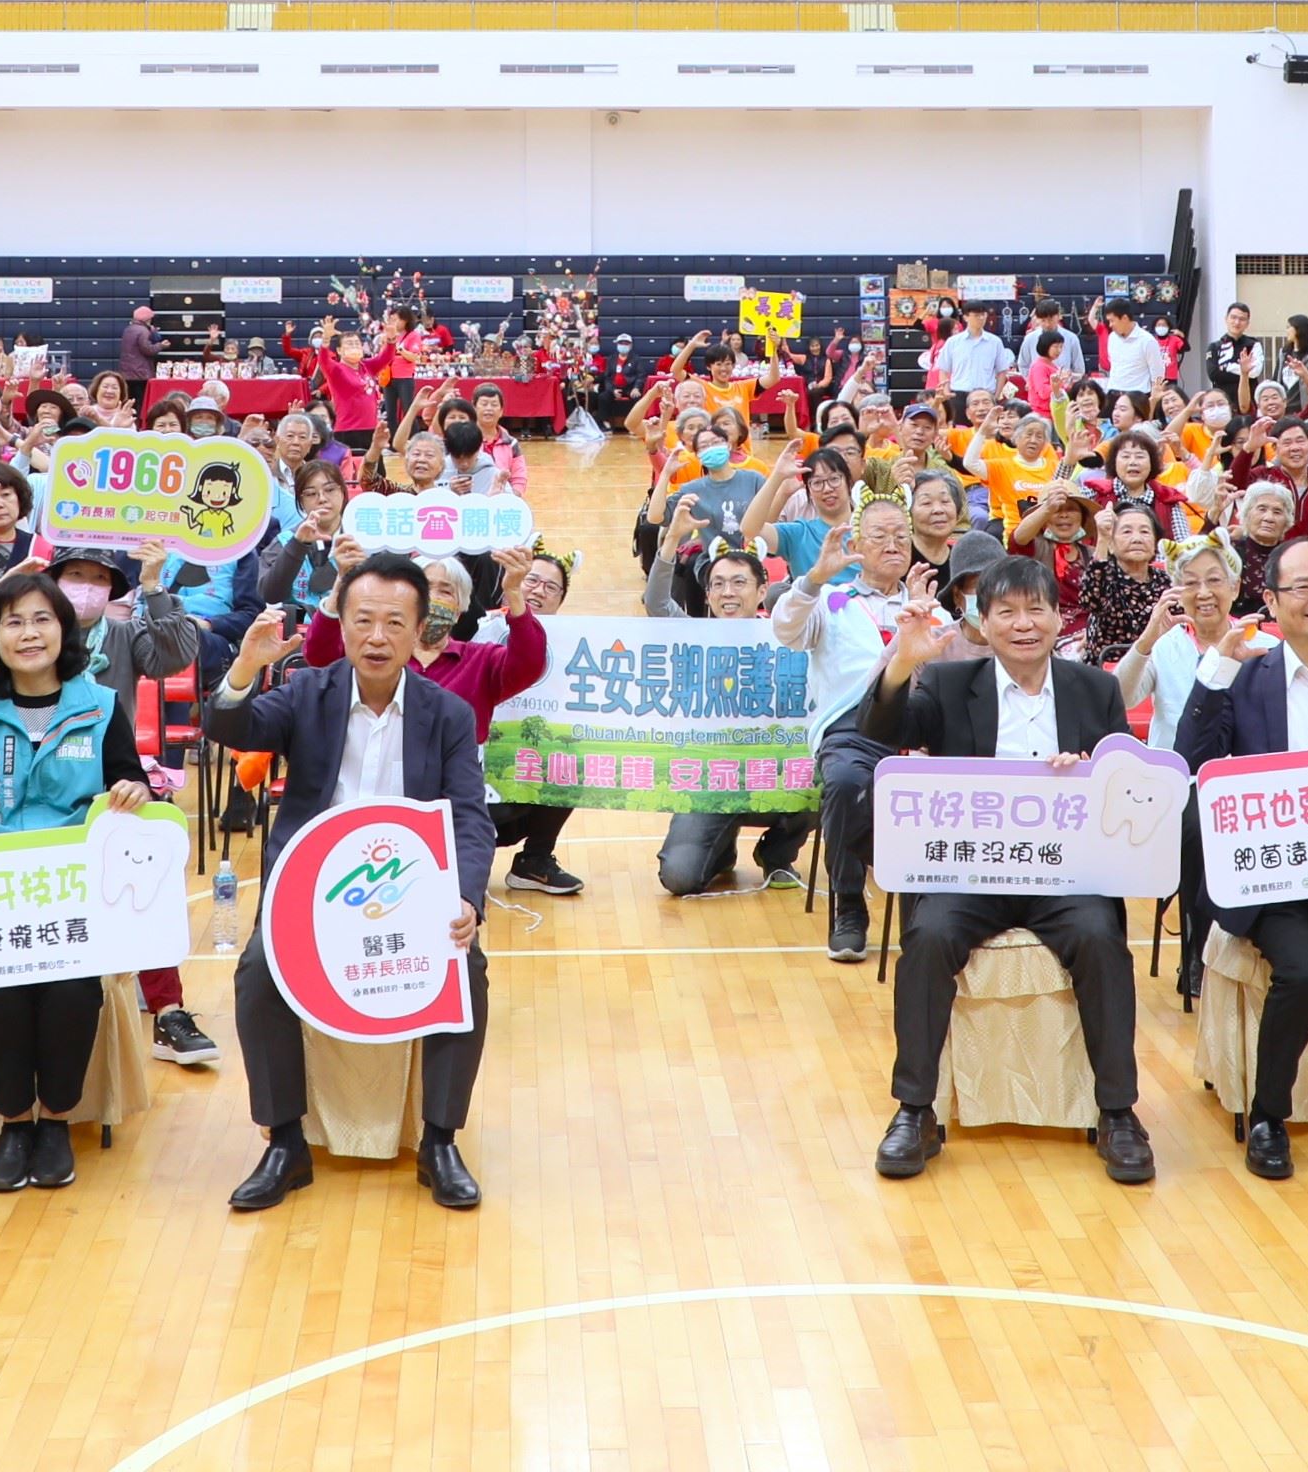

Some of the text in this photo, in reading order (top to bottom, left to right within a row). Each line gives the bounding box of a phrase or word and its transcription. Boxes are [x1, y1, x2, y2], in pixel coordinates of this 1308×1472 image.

[95, 448, 185, 495] 1966
[354, 507, 523, 538] 電話 關懷
[650, 724, 730, 749] long-term
[732, 726, 772, 744] Care
[514, 748, 816, 792] 全心照護 安家醫療
[890, 790, 1089, 832] 牙好胃口好
[924, 839, 1063, 866] 健康沒煩惱
[362, 932, 407, 957] 醫事
[343, 955, 430, 982] 巷弄長照站
